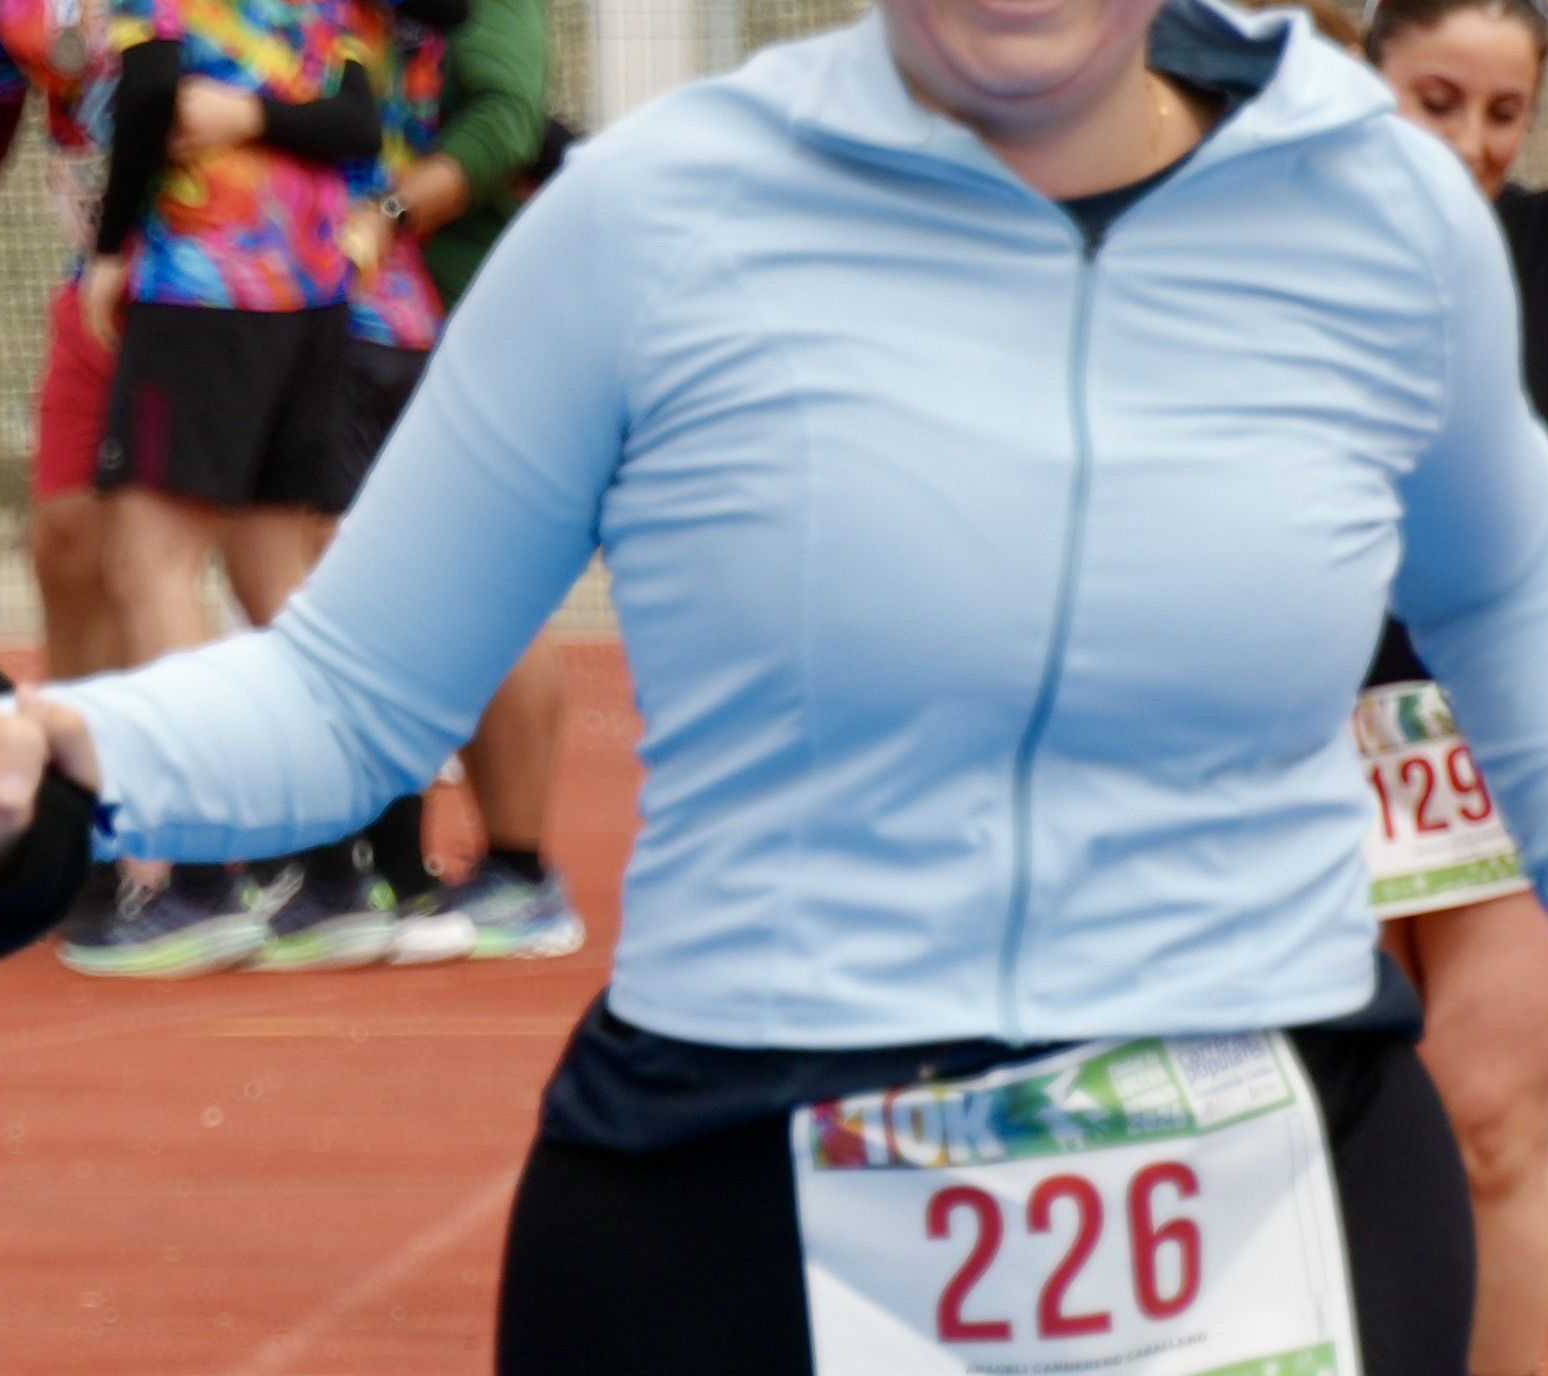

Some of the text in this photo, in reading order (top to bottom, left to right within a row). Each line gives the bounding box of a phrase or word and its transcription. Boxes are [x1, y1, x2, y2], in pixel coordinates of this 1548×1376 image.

[1370, 744, 1493, 842] 129
[842, 1088, 1005, 1166] 10K
[925, 1160, 1203, 1343] 226
